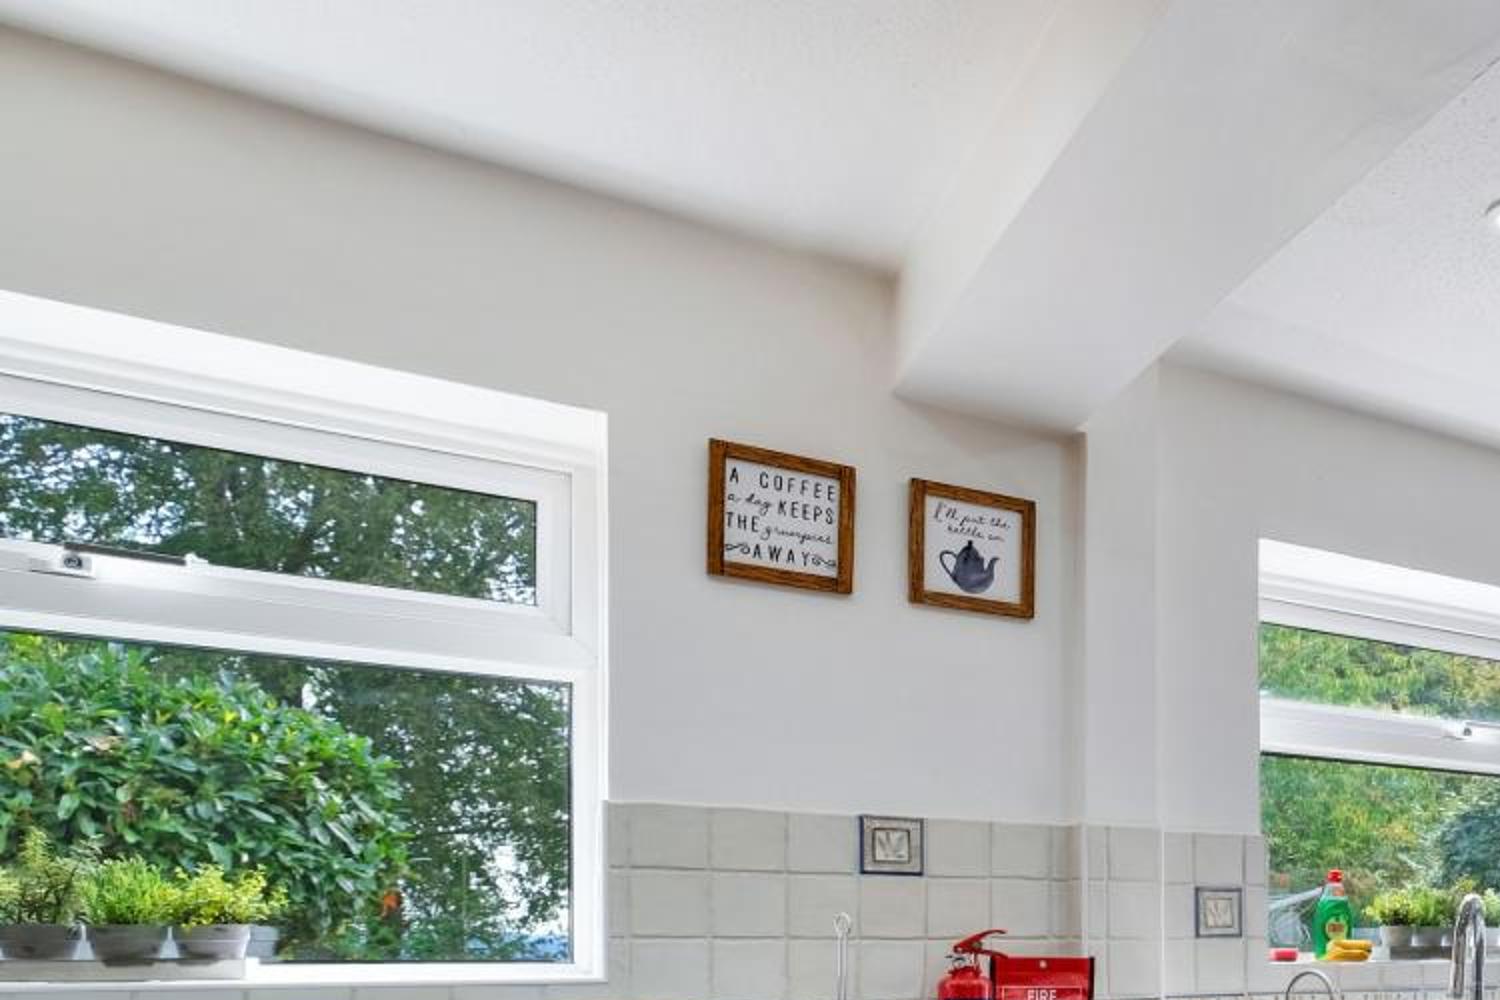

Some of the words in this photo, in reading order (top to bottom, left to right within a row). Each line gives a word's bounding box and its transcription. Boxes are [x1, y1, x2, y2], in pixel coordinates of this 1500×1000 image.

[729, 467, 739, 484] A
[759, 471, 836, 502] COFFEE
[726, 511, 760, 533] THE
[778, 499, 834, 525] KEEPS
[752, 543, 810, 567] AWAY
